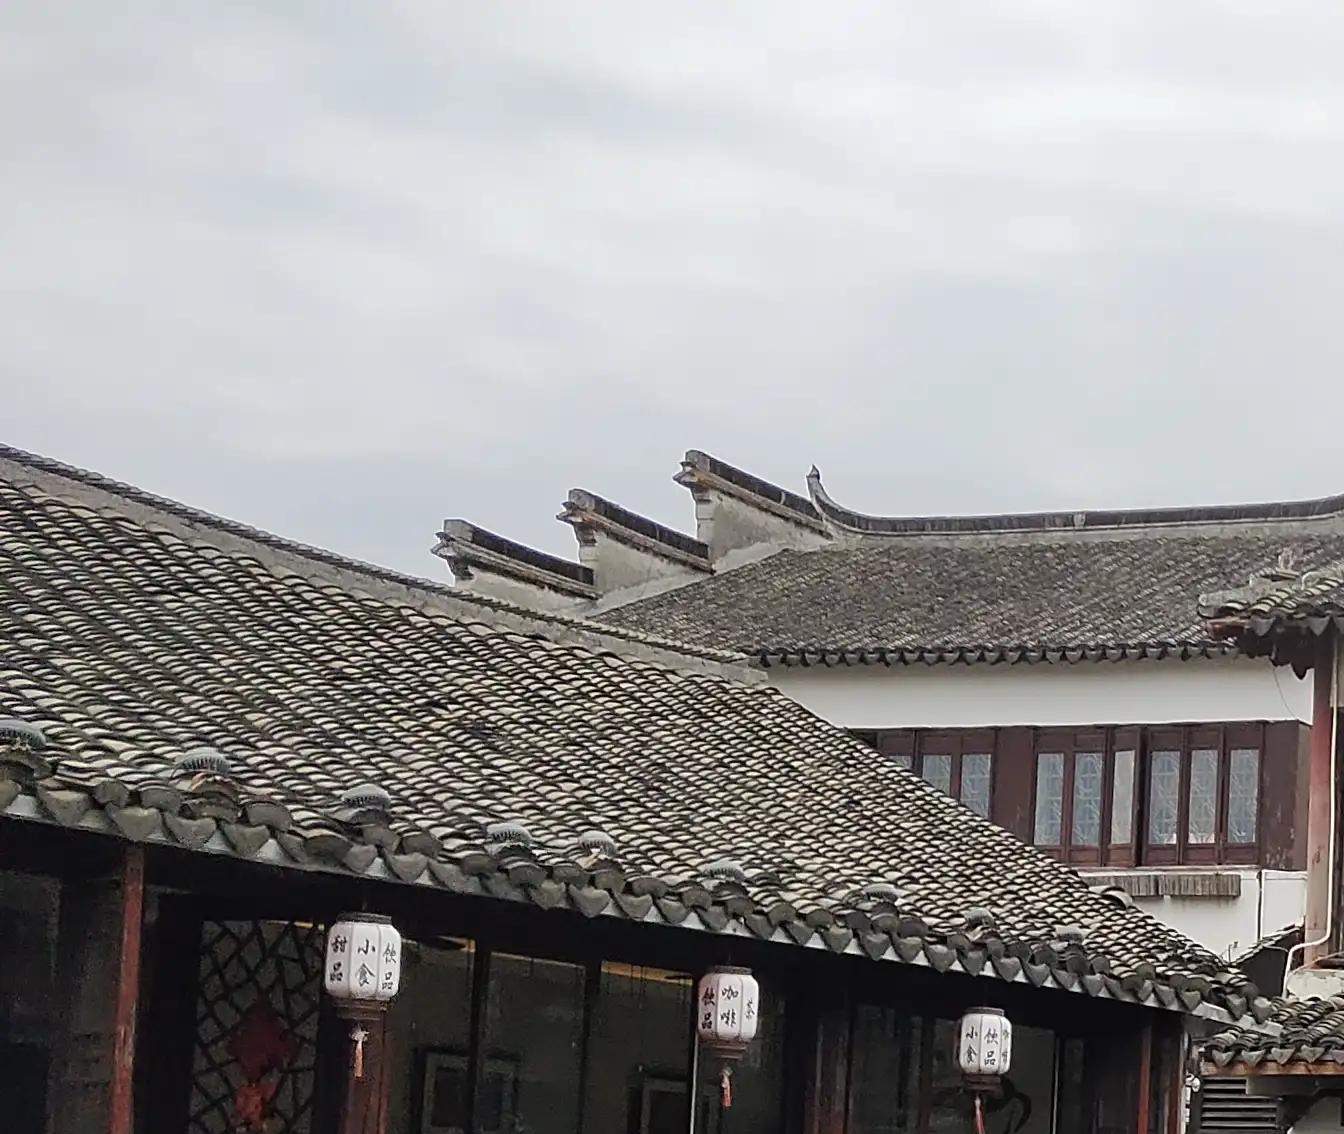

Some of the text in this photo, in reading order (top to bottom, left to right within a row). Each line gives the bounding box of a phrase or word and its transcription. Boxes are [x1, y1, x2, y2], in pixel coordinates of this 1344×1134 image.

[331, 935, 347, 981] 甜品
[355, 939, 375, 987] 小食
[382, 941, 397, 990] 饮品
[701, 987, 715, 1029] 饮品
[721, 985, 739, 1027] 咖啡
[965, 1026, 978, 1064] 小食
[984, 1028, 999, 1066] 饮品
